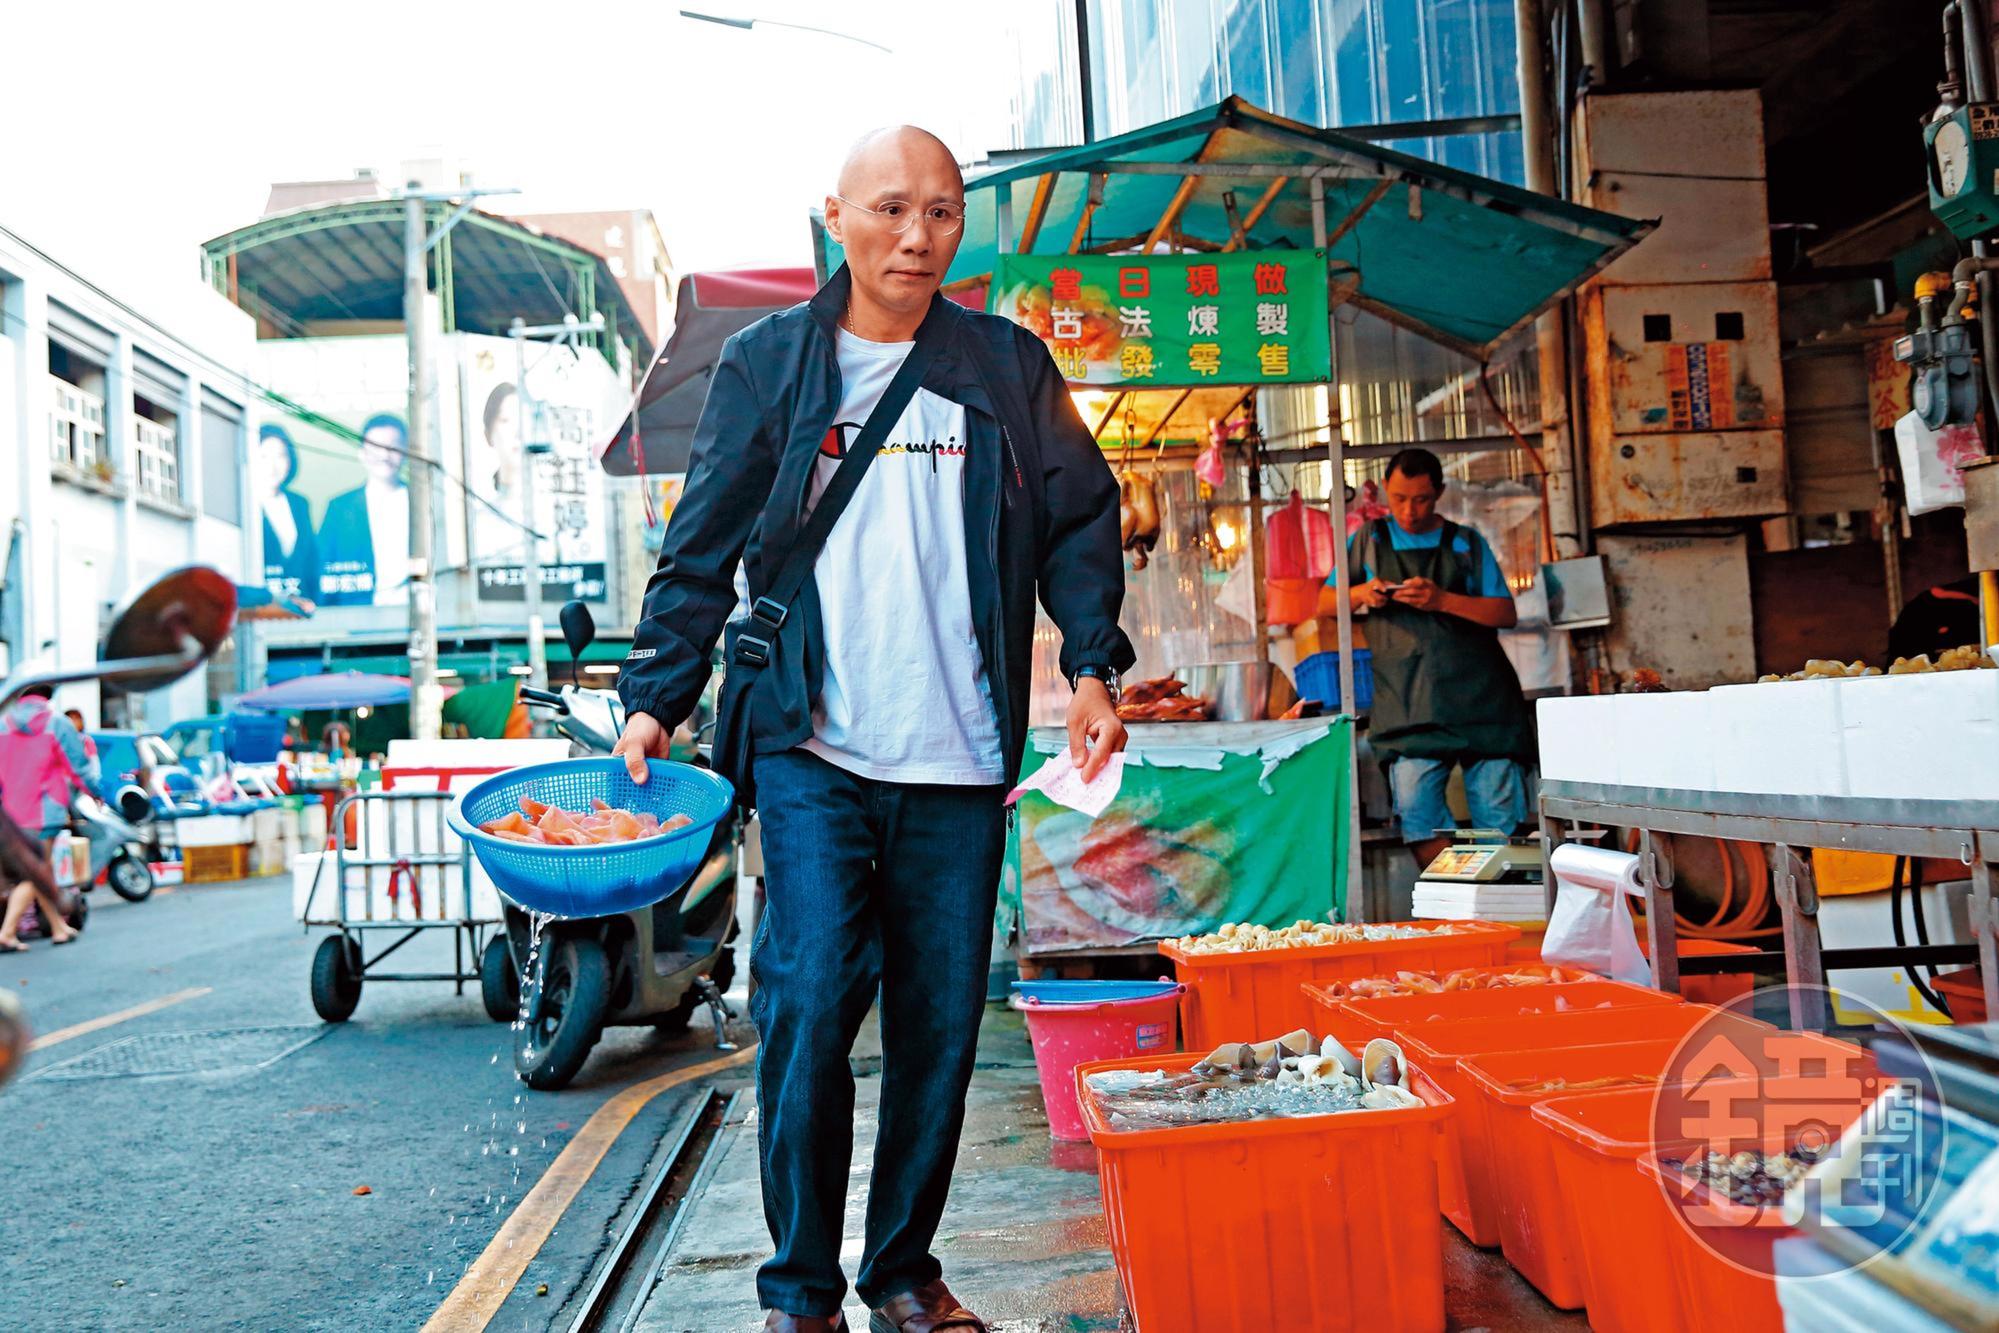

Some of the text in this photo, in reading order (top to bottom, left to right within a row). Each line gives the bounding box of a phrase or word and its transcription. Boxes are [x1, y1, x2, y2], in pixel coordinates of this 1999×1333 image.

[1049, 263, 1288, 300] 當日現做
[1050, 303, 1288, 340] 古法煉製
[1054, 343, 1289, 379] 批發零售
